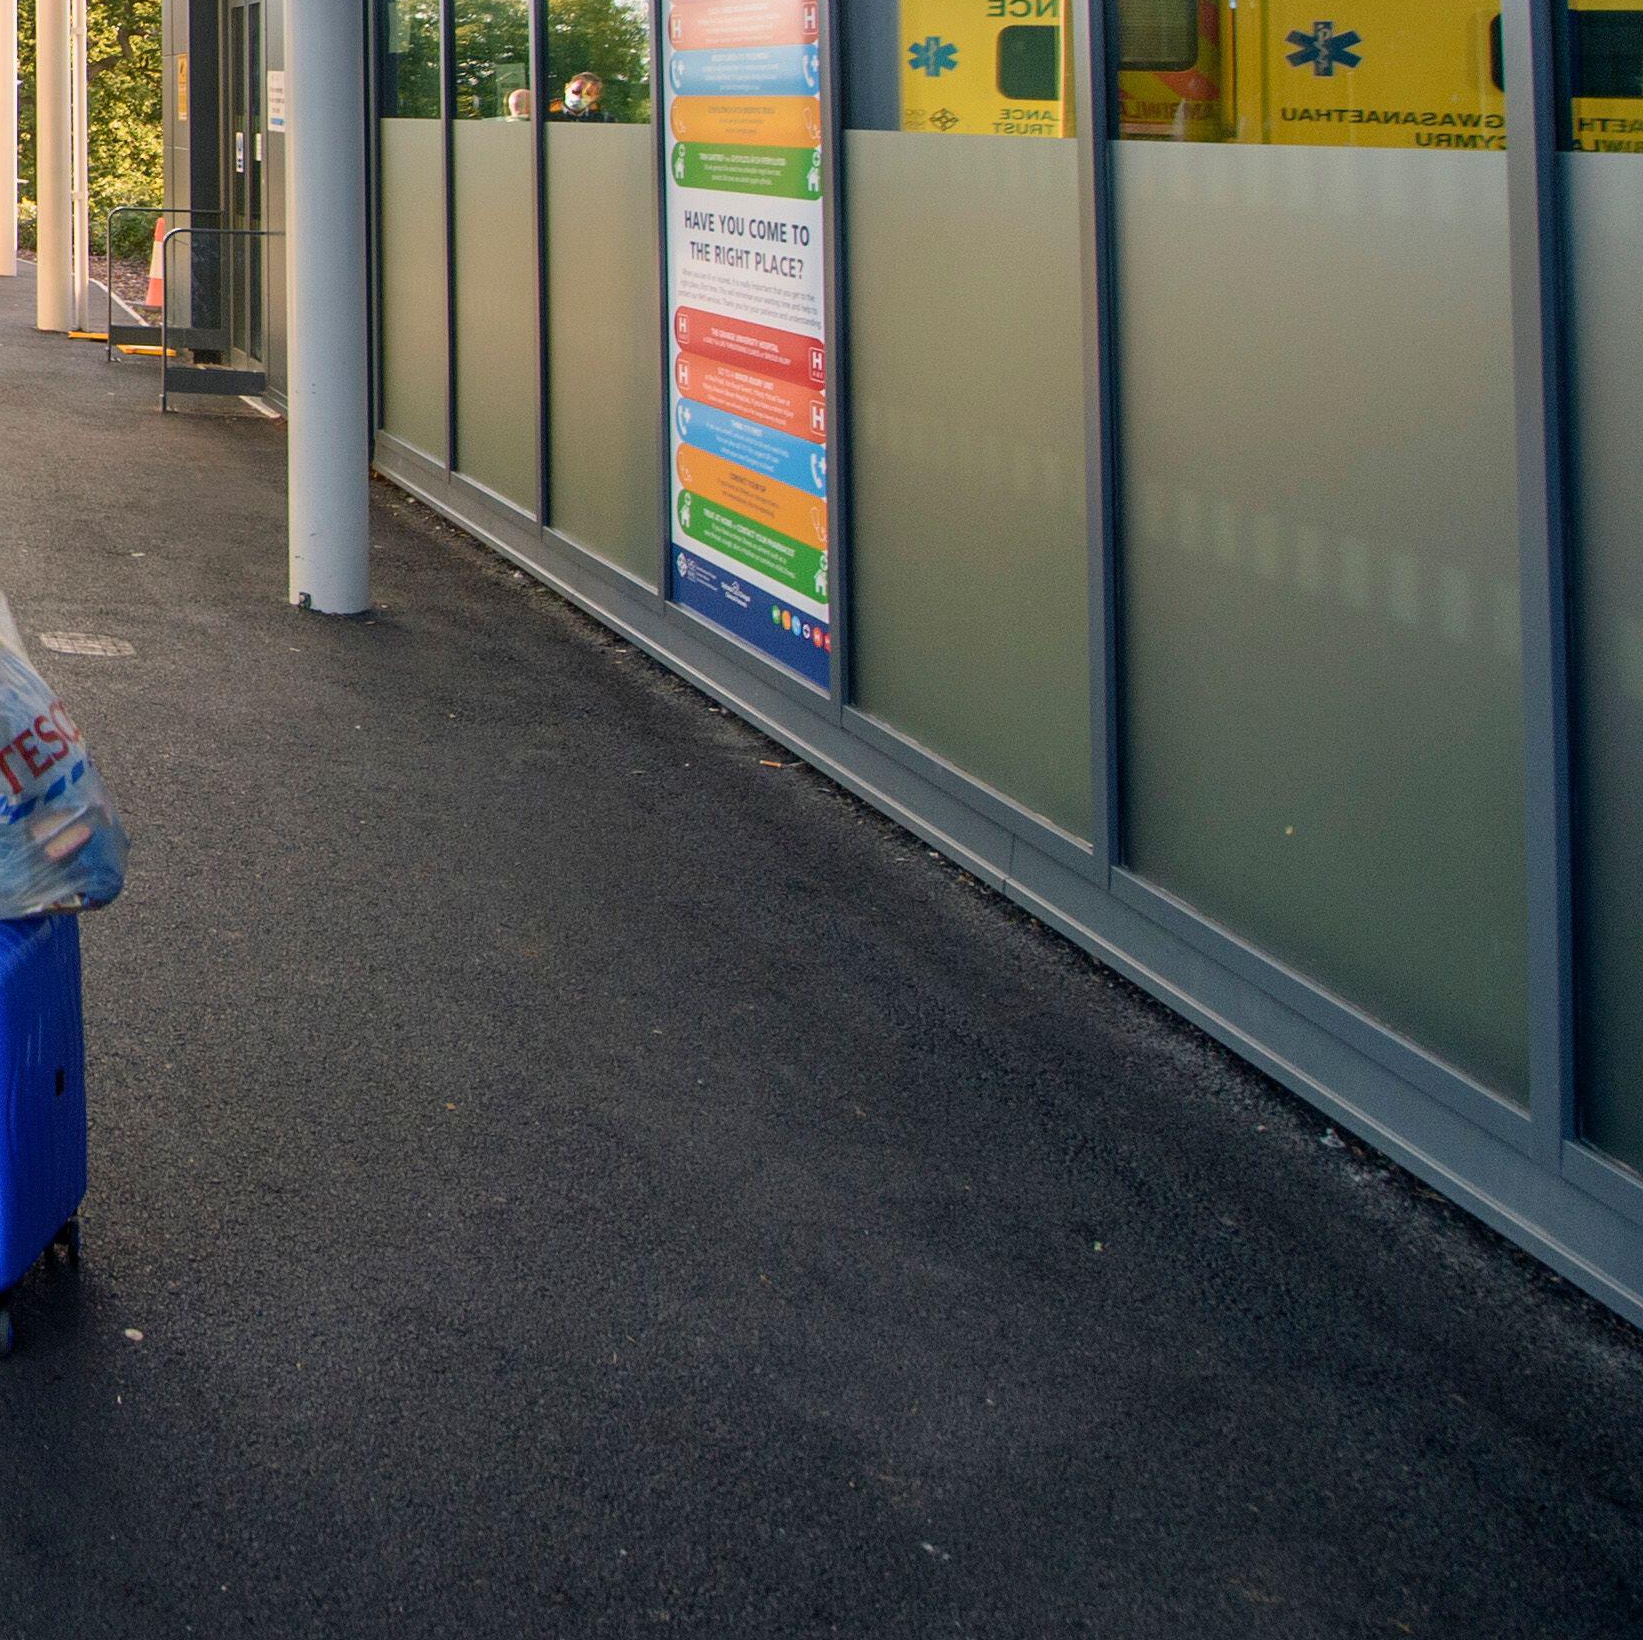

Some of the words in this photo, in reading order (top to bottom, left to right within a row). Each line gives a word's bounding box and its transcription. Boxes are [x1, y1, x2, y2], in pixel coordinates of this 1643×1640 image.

[684, 210, 715, 233] HAVE
[719, 214, 745, 237] YOU
[749, 218, 788, 244] COME
[792, 224, 810, 247] TO
[690, 241, 711, 263] THE
[714, 245, 751, 270] RIGHT
[755, 252, 804, 280] PLACE?
